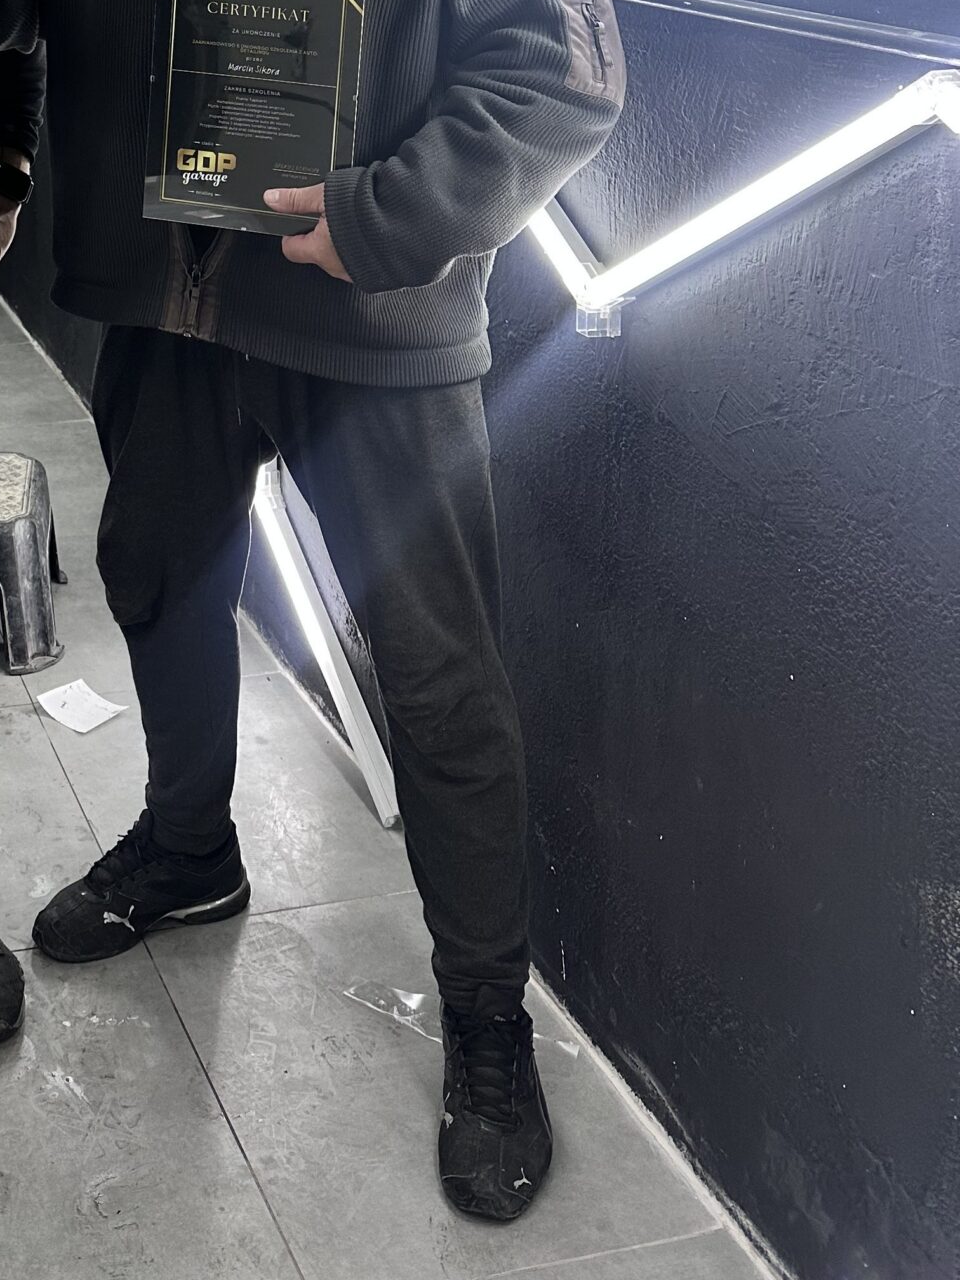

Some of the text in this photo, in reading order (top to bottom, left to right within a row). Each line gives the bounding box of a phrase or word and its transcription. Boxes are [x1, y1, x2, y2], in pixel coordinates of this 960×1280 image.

[206, 1, 311, 23] CERTYFIKAT
[227, 62, 281, 76] Marcin Sikora
[248, 87, 281, 96] SZKOLENIA
[176, 147, 237, 173] GDP
[182, 171, 228, 187] garage
